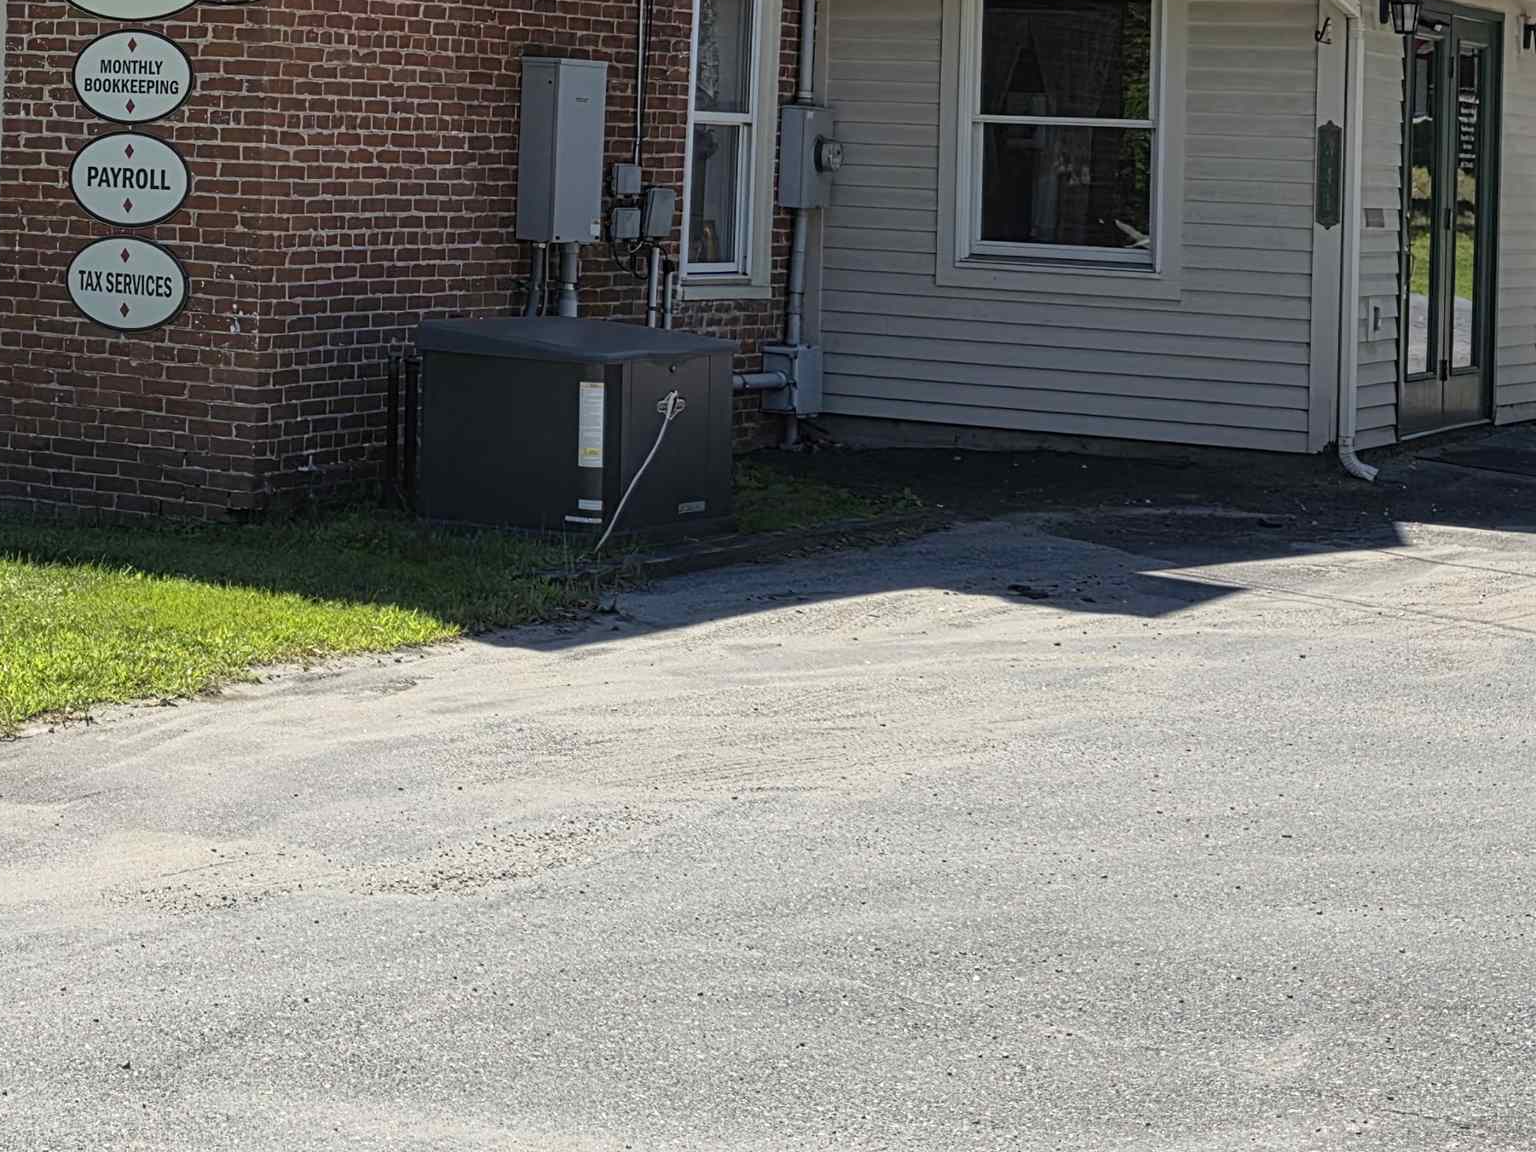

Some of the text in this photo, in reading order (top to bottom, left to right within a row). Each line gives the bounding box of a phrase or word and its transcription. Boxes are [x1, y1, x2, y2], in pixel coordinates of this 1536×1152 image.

[100, 59, 163, 75] MONTHLY
[84, 77, 179, 95] BOOKKEEPING
[87, 166, 170, 190] PAYROLL
[78, 270, 172, 298] TAX SERVICES
